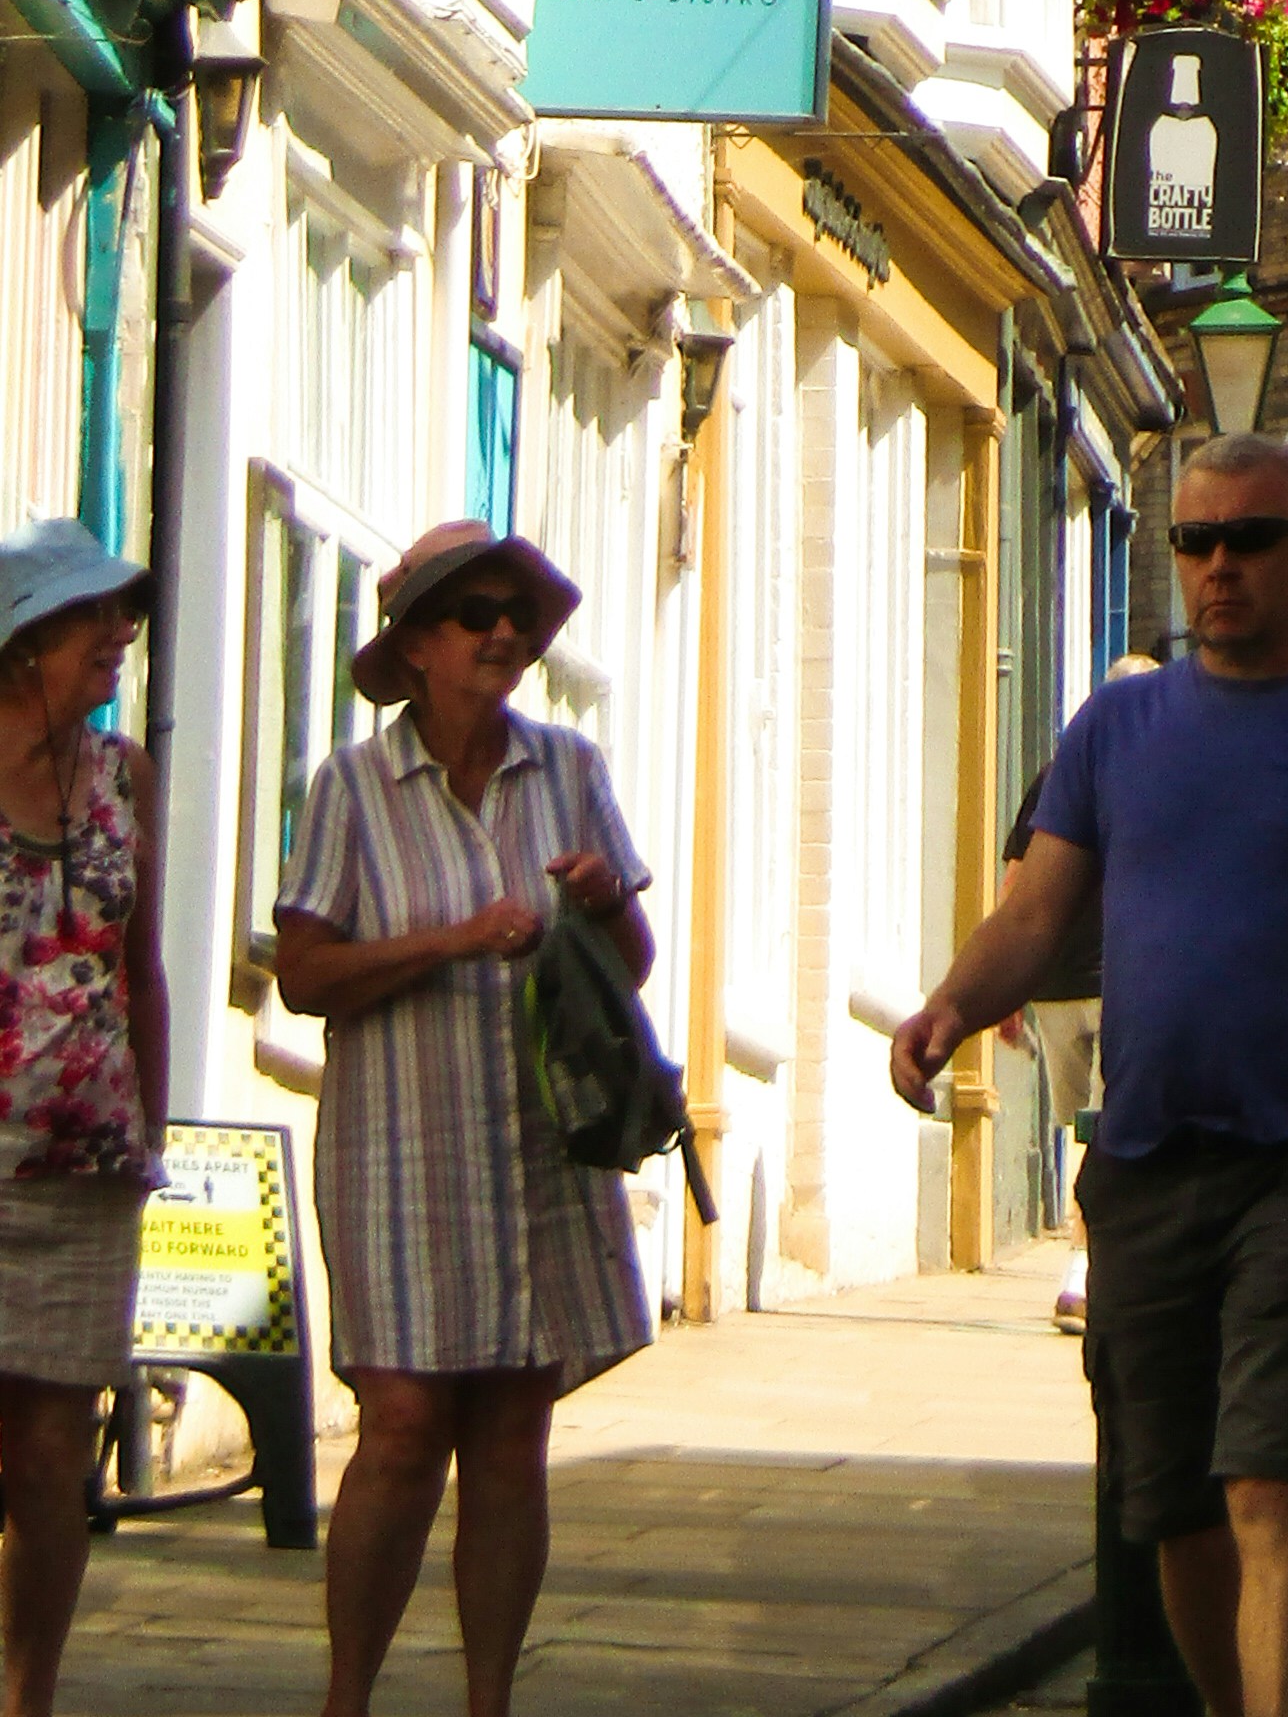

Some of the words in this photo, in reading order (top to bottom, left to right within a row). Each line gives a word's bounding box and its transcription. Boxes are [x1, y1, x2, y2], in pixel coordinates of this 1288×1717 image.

[1149, 184, 1213, 208] CRAFTY
[1148, 206, 1212, 230] BOTTLE
[162, 1158, 200, 1172] TRES
[203, 1159, 249, 1174] APART
[180, 1221, 224, 1236] HERE
[167, 1241, 249, 1258] FORWARD
